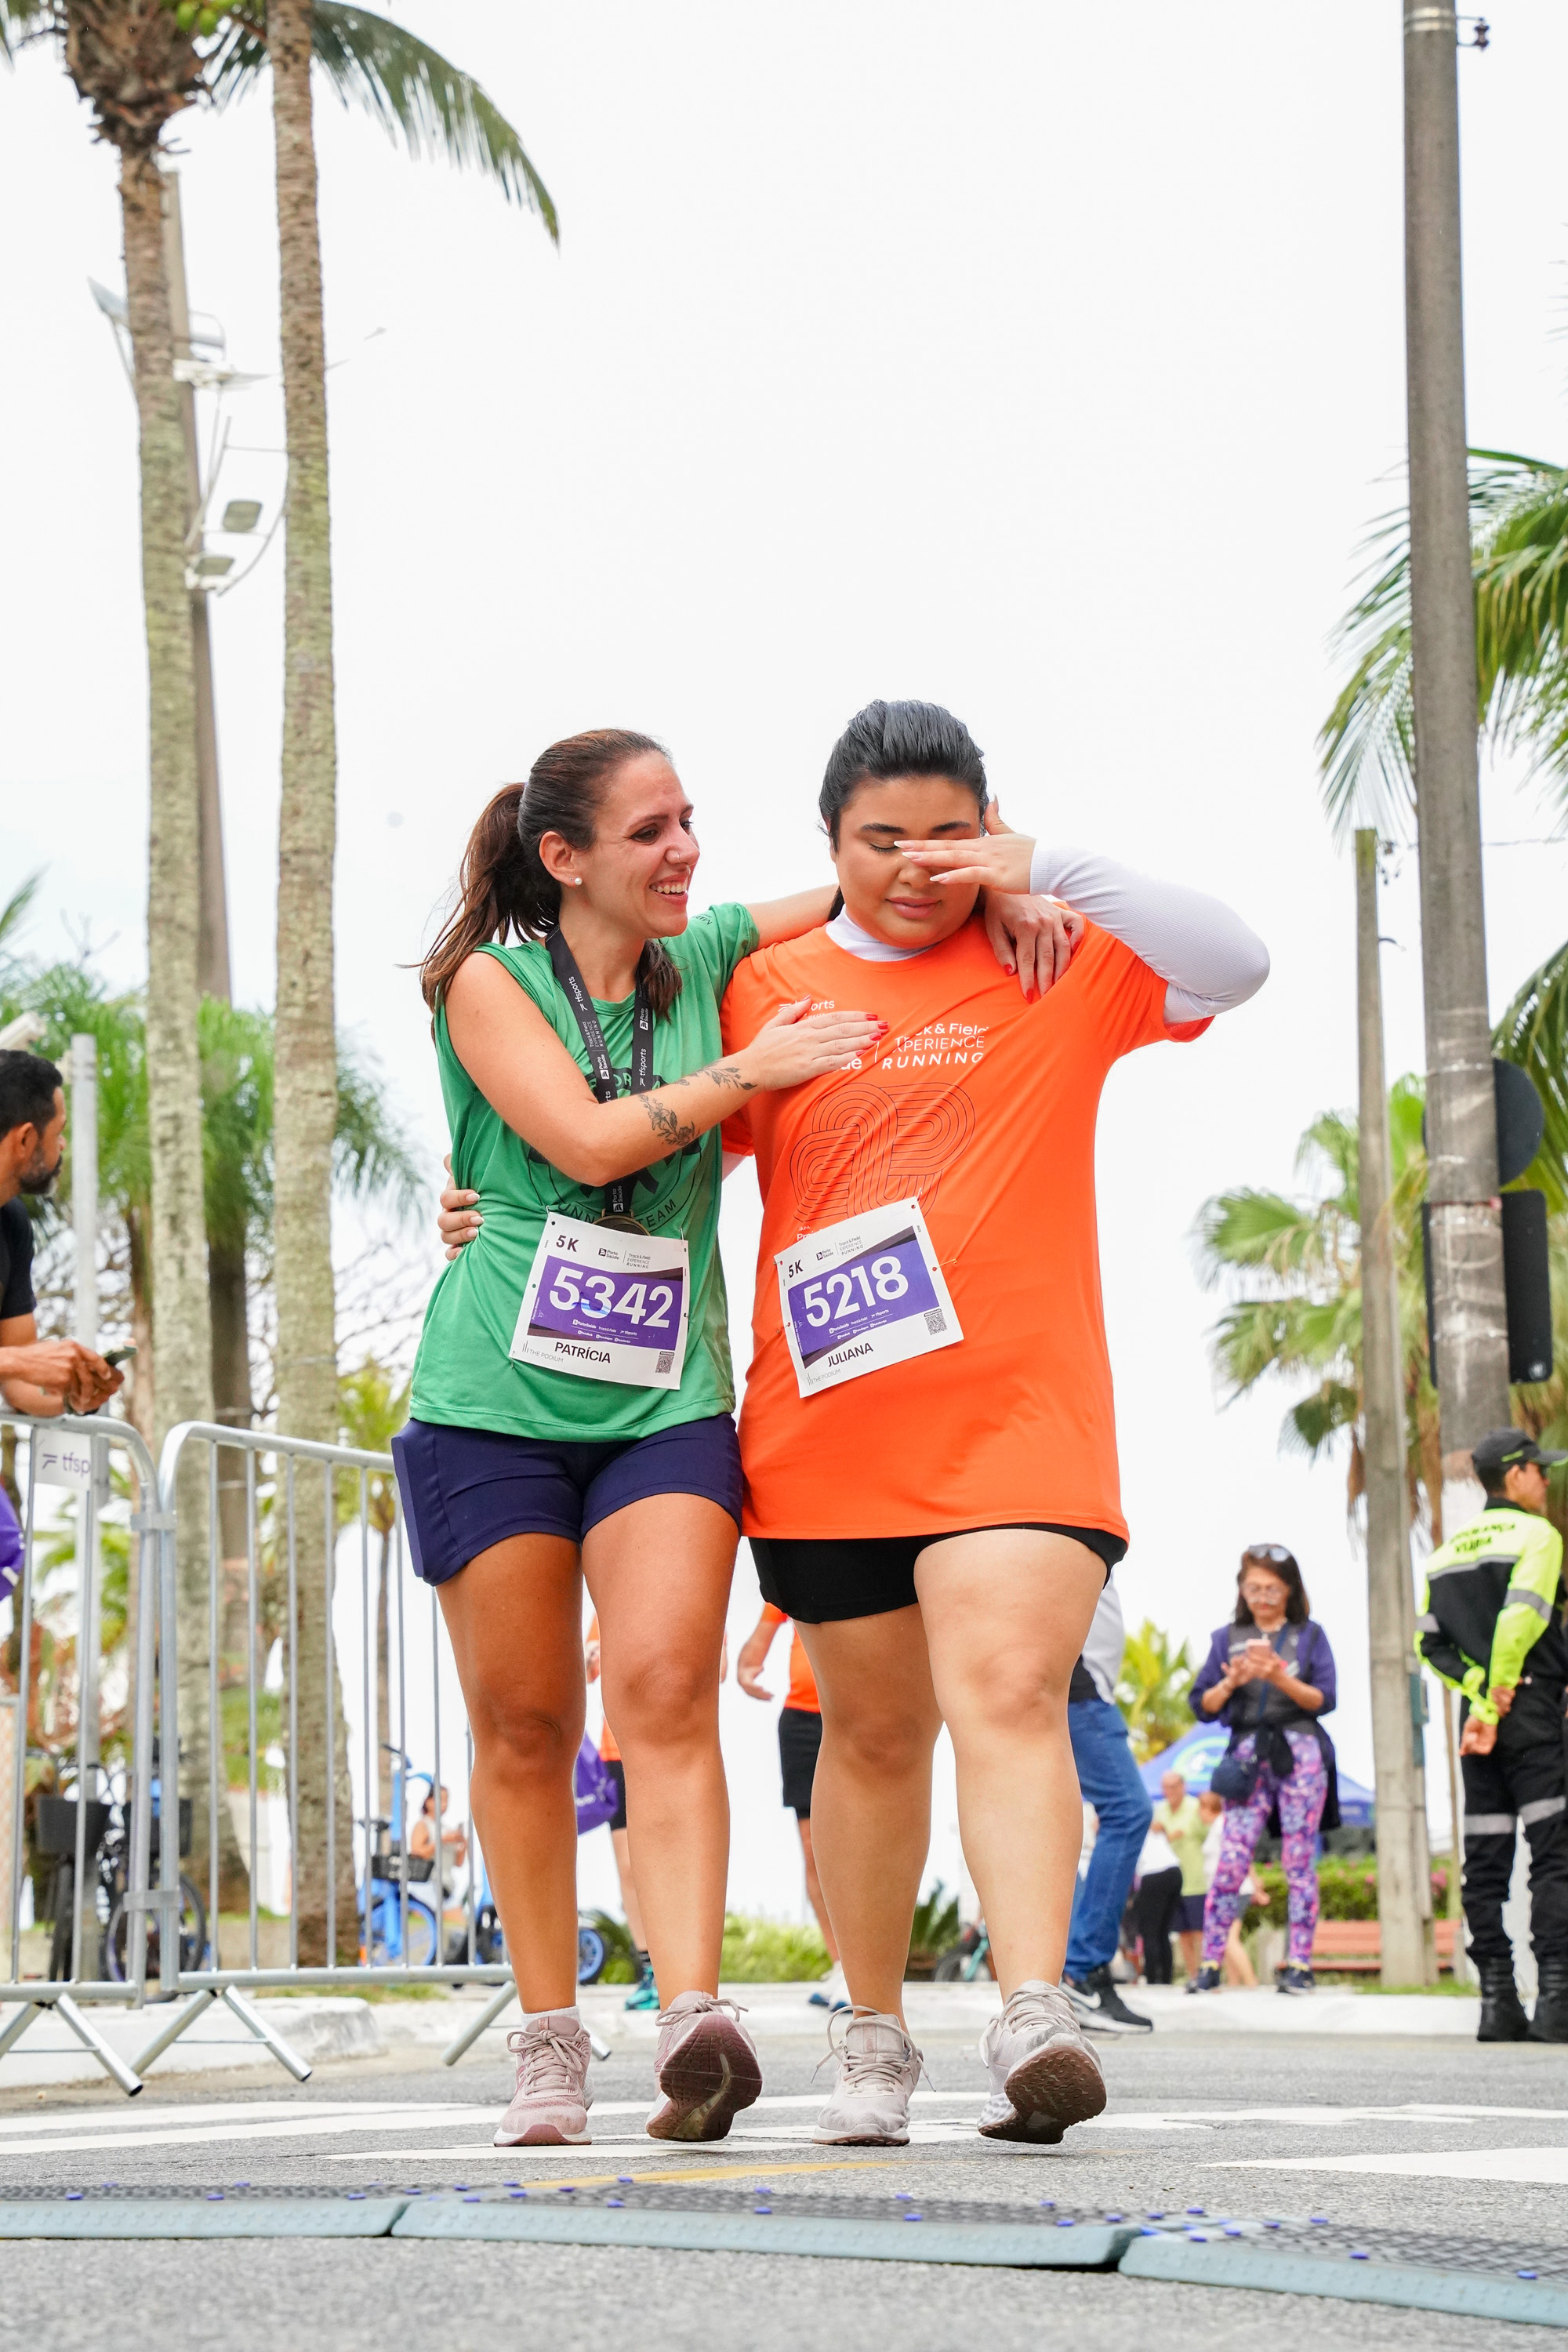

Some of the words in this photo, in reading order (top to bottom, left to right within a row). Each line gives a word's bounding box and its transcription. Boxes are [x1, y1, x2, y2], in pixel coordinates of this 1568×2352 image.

[568, 976, 583, 1003] tfsports
[591, 1020, 604, 1047] RUNNING
[935, 1023, 945, 1034] &
[882, 1052, 984, 1070] RUNNING
[840, 1240, 862, 1252] EXPERIENCE
[841, 1244, 864, 1255] RUNNING
[550, 1266, 673, 1328] 5342
[804, 1256, 909, 1327] 5218
[541, 1352, 564, 1363] PODIUM
[554, 1341, 611, 1363] PATRÍCIA
[827, 1342, 873, 1367] JULIANA
[821, 1368, 841, 1380] PODIUM
